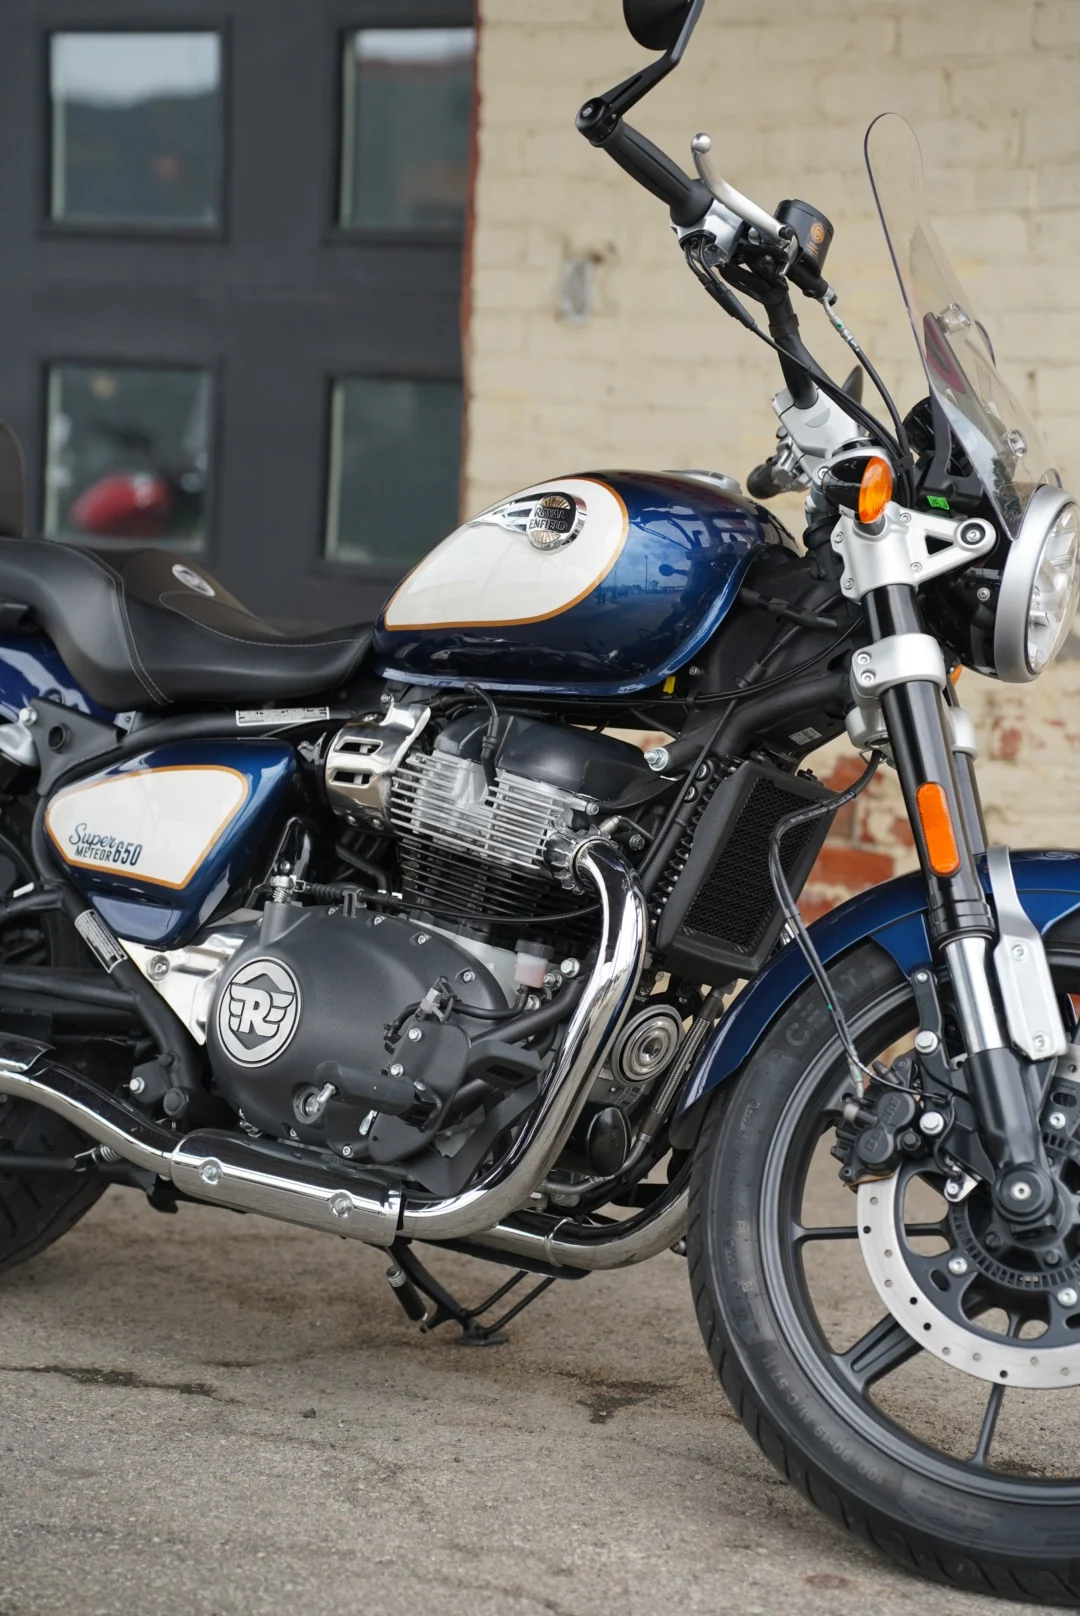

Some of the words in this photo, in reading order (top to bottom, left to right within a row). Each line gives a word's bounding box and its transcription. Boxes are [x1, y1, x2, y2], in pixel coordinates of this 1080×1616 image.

[534, 506, 567, 520] ROYAL
[529, 518, 568, 531] ENFIELD
[68, 821, 117, 850] Super
[75, 844, 113, 862] METEOR
[112, 840, 144, 866] 650
